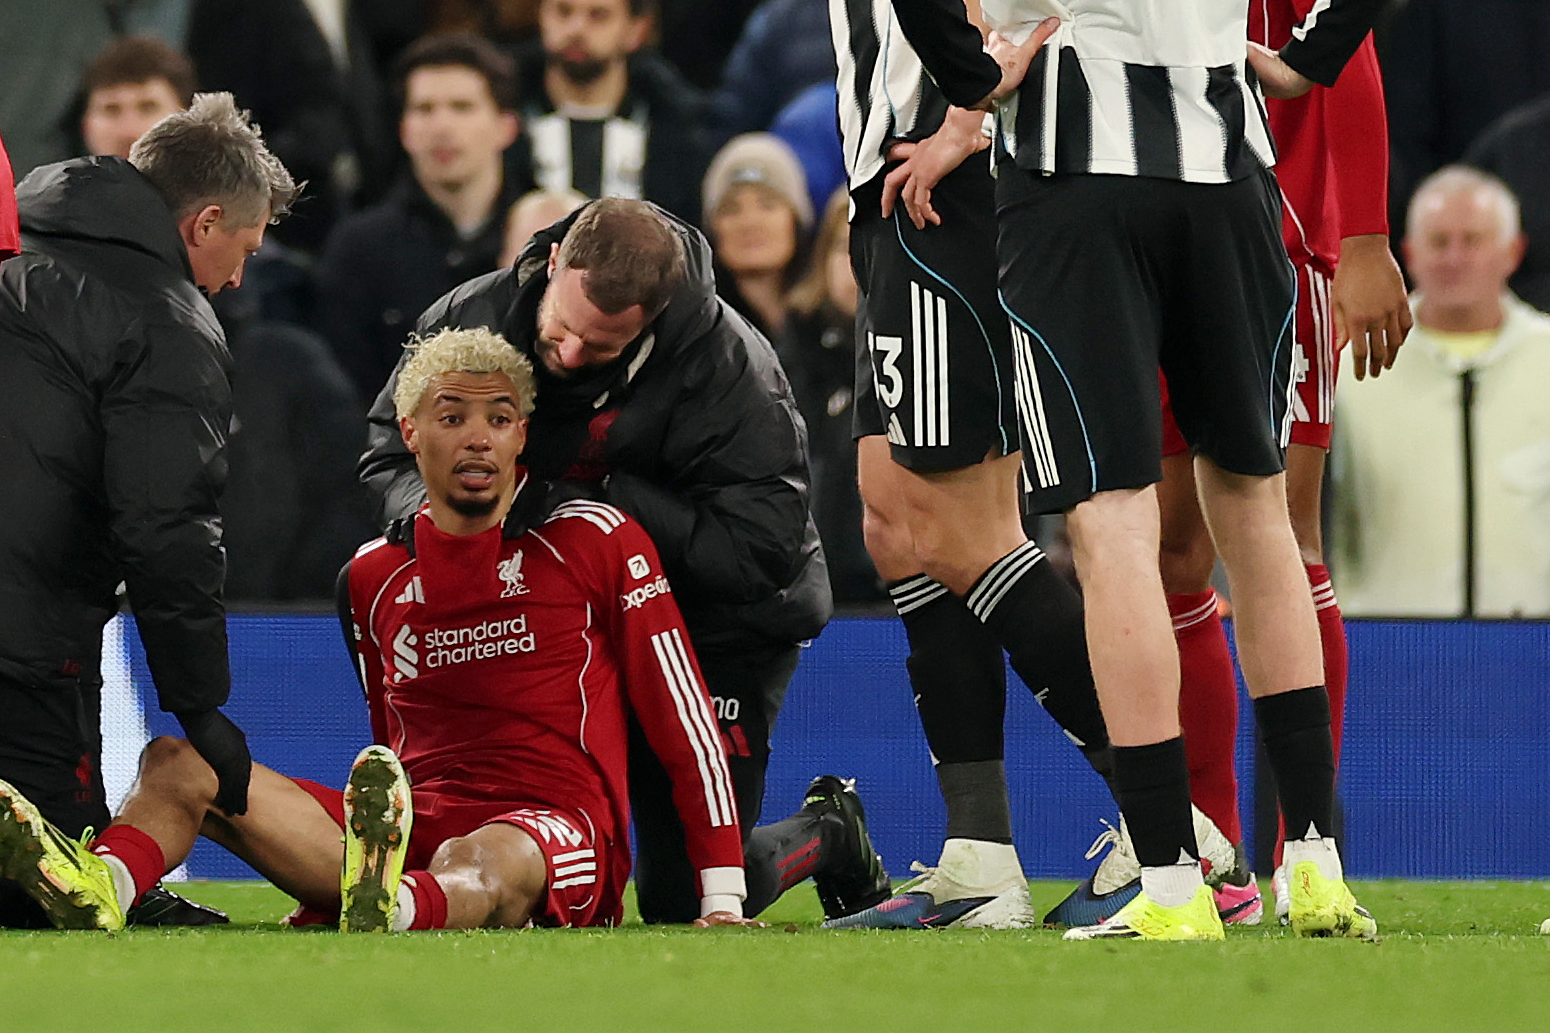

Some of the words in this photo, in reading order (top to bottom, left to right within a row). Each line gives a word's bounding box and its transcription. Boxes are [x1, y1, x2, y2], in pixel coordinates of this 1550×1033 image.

[868, 331, 903, 409] 3
[425, 613, 527, 649] standard
[426, 632, 536, 668] chartered
